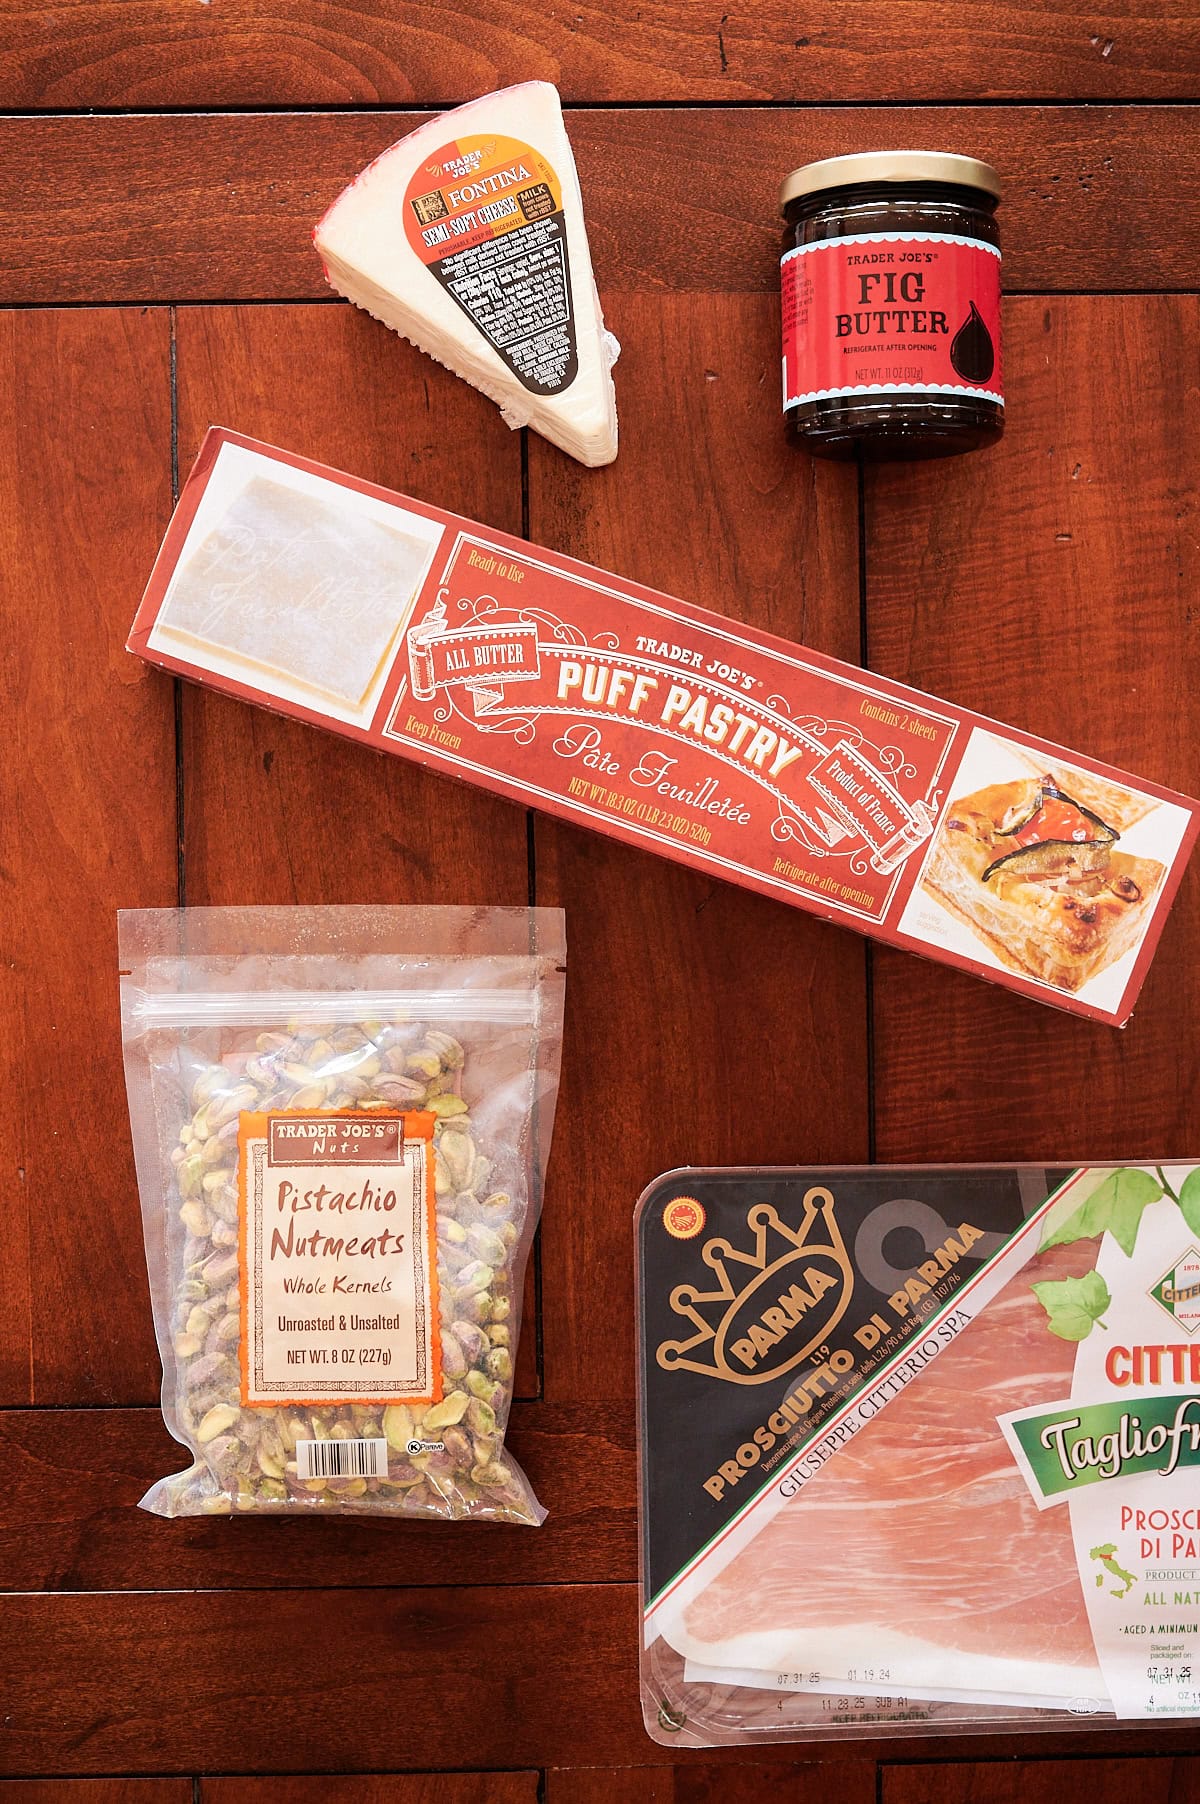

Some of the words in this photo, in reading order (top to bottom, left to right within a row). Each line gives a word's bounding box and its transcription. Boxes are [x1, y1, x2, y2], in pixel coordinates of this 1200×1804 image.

[442, 150, 482, 172] TRADER
[452, 160, 480, 178] JOE'S
[448, 164, 532, 208] FONTINA
[421, 212, 478, 247] SEMI-SOFT
[476, 195, 519, 225] CHEESE
[472, 231, 485, 242] KEEP
[847, 254, 895, 266] TRADER
[858, 272, 925, 305] FIG
[835, 311, 949, 337] BUTTER
[843, 344, 885, 354] REFRIGERATE
[886, 344, 906, 352] AFTER
[908, 344, 937, 352] OPENING
[855, 368, 869, 381] NET
[870, 367, 884, 380] WT.
[885, 367, 891, 378] 11
[892, 367, 903, 378] OZ
[904, 366, 923, 381] (312g)
[467, 549, 498, 576] Ready
[497, 561, 507, 576] to
[505, 563, 525, 584] Use
[446, 650, 470, 671] ALL
[474, 643, 524, 666] BUTTER
[635, 636, 704, 669] TRADER
[405, 714, 430, 739] Keep
[428, 724, 462, 750] Frozen
[557, 660, 659, 714] PUFF
[660, 684, 802, 778] PASTRY
[859, 699, 902, 728] Contains
[900, 714, 909, 729] 2
[907, 719, 938, 742] sheets
[552, 724, 621, 776] Pâte
[629, 750, 751, 825] Feuilletée
[825, 759, 859, 798] Product
[857, 788, 871, 806] of
[866, 798, 896, 835] France
[568, 777, 590, 796] NET
[589, 784, 606, 803] WT.
[605, 789, 624, 811] 18.3
[622, 797, 638, 816] OZ
[644, 805, 660, 824] LB
[671, 815, 691, 836] OZ)
[689, 823, 712, 846] 520g
[772, 857, 820, 888] Refrigerate
[818, 874, 840, 894] after
[840, 884, 875, 908] opening
[277, 1125, 337, 1138] TRADER
[313, 1137, 359, 1155] Nuts
[278, 1179, 397, 1214] Pistachio
[271, 1216, 405, 1262] Nutmeats
[283, 1276, 326, 1294] Whole
[333, 1275, 393, 1294] Kernels
[1164, 1283, 1200, 1300] CITTE
[278, 1315, 334, 1332] Unroasted
[339, 1315, 347, 1331] &
[350, 1314, 400, 1331] Unsalted
[729, 1266, 839, 1370] PARMA
[287, 1350, 306, 1364] NET
[310, 1349, 329, 1364] WT.
[332, 1349, 338, 1363] 8
[341, 1349, 355, 1364] OZ
[359, 1348, 392, 1365] (227g)
[702, 1349, 855, 1502] PROSCIUTTO
[853, 1313, 892, 1352] DI
[887, 1222, 985, 1317] PARMA
[761, 1432, 802, 1471] Denominazione
[798, 1425, 806, 1433] di
[804, 1407, 826, 1429] Origine
[821, 1389, 843, 1410] Protetta
[841, 1383, 849, 1391] ai
[847, 1370, 862, 1385] sensi
[859, 1357, 875, 1372] della
[900, 1323, 910, 1334] del
[779, 1420, 861, 1498] GIUSEPPE
[858, 1339, 940, 1419] CITTERIO
[938, 1310, 973, 1342] SPA
[421, 1443, 443, 1451] Pareve
[1141, 1537, 1160, 1559] DI
[1172, 1533, 1200, 1558] PA
[1145, 1570, 1197, 1580] PRODUCT
[1144, 1591, 1167, 1606] ALL
[1149, 1624, 1155, 1634] A
[777, 1700, 783, 1711] 4
